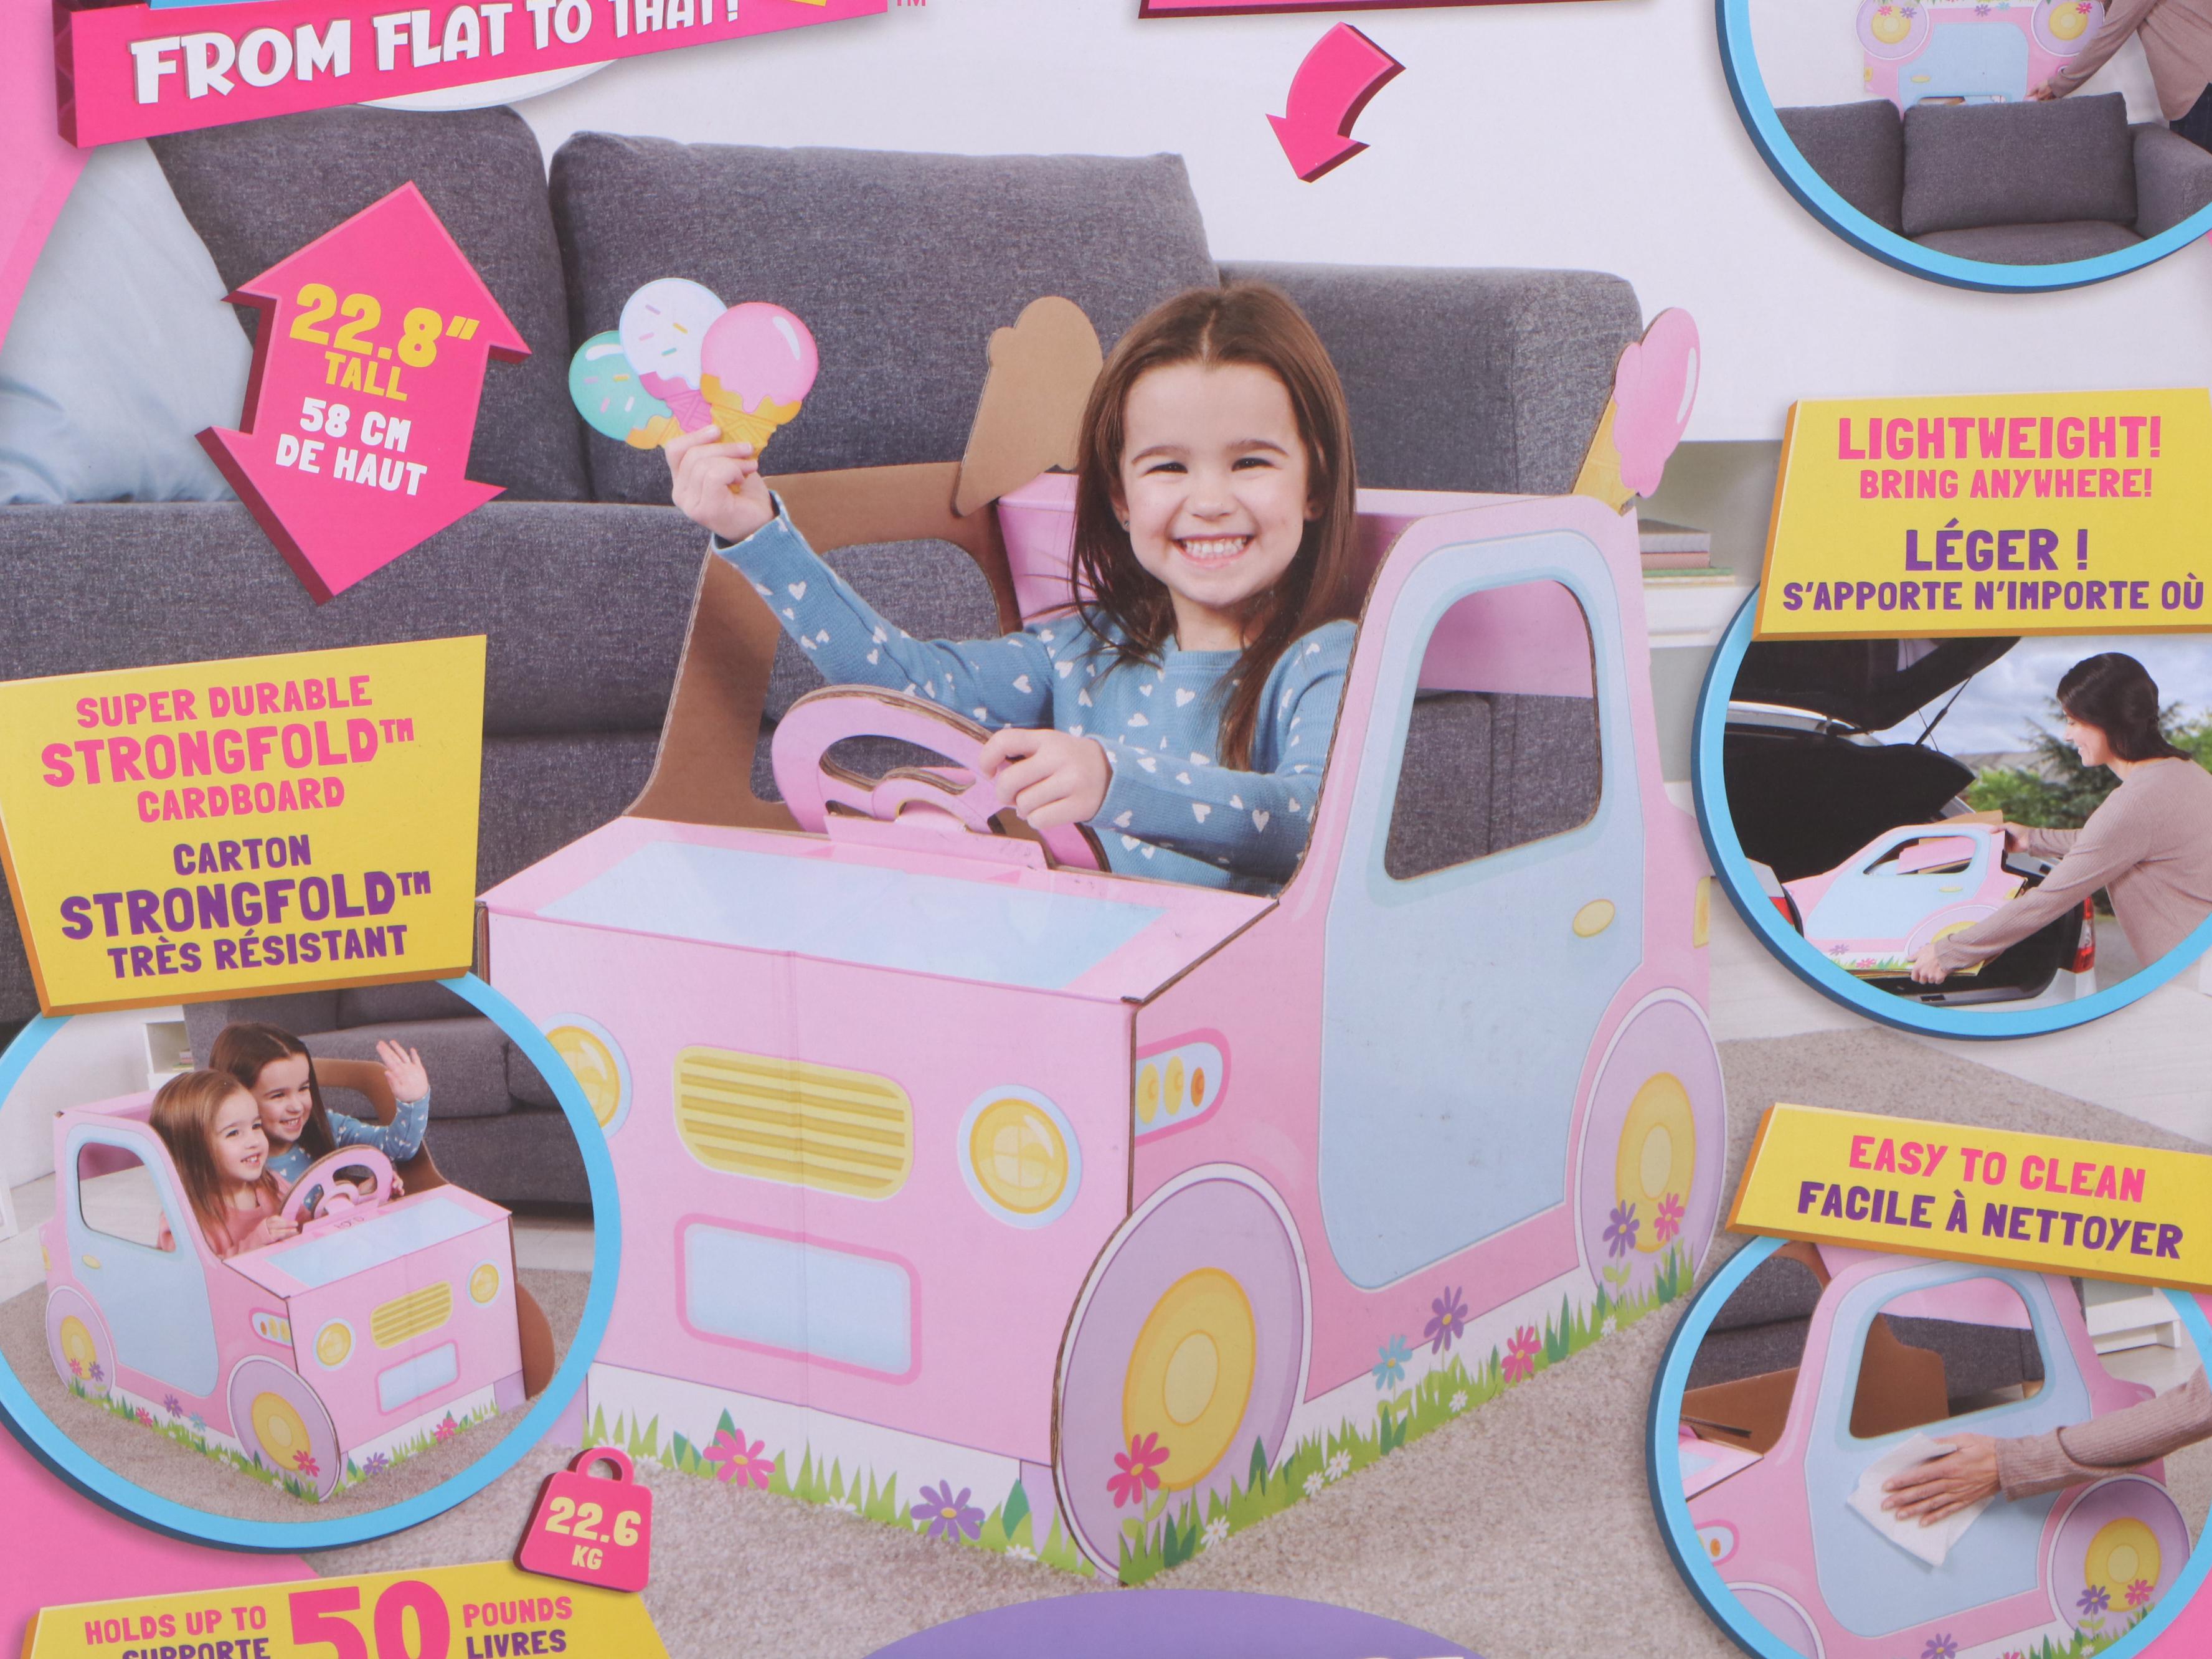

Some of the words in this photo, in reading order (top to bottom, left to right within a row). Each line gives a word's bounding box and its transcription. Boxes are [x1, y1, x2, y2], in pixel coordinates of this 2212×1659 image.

[129, 19, 351, 105] FROM
[373, 5, 513, 71] FLAT
[527, 0, 592, 50] TO
[289, 283, 480, 367] 22.8"
[324, 351, 407, 401] TALL
[300, 397, 350, 437] 58
[361, 411, 411, 453] CM
[1838, 415, 2161, 460] LIGHTWEIGHT!
[276, 433, 324, 473] DE
[333, 447, 427, 496] HAUT
[1860, 469, 1958, 499] BRING
[1970, 468, 2152, 498] ANYWHERE!
[1905, 517, 2059, 571] LÉGER
[2077, 529, 2088, 570] !
[1783, 580, 1962, 611] S'APPORTE
[1975, 580, 2148, 610] N'IMPORTE
[2162, 572, 2204, 610] OÙ
[76, 688, 197, 728] SUPER
[209, 674, 372, 718] DURABLE
[137, 777, 345, 823] CARDBOARD
[173, 834, 311, 876] CARTON
[108, 935, 202, 979] TRÈS
[214, 924, 407, 970] RÉSISTANT
[1849, 1135, 1949, 1178] EASY
[1961, 1148, 2007, 1186] TO
[2020, 1155, 2146, 1203] CLEAN
[1798, 1181, 1936, 1228] FACILE
[1945, 1189, 1968, 1234] À
[1982, 1203, 2183, 1259] NETTOYER
[545, 1496, 641, 1547] 22.6
[572, 1544, 603, 1570] KG
[85, 1614, 176, 1645] HOLDS
[186, 1609, 222, 1635] UP
[231, 1605, 266, 1631] TO
[288, 1580, 450, 1659] 50
[463, 1596, 572, 1628] POUNDS
[466, 1629, 567, 1659] LIVRES
